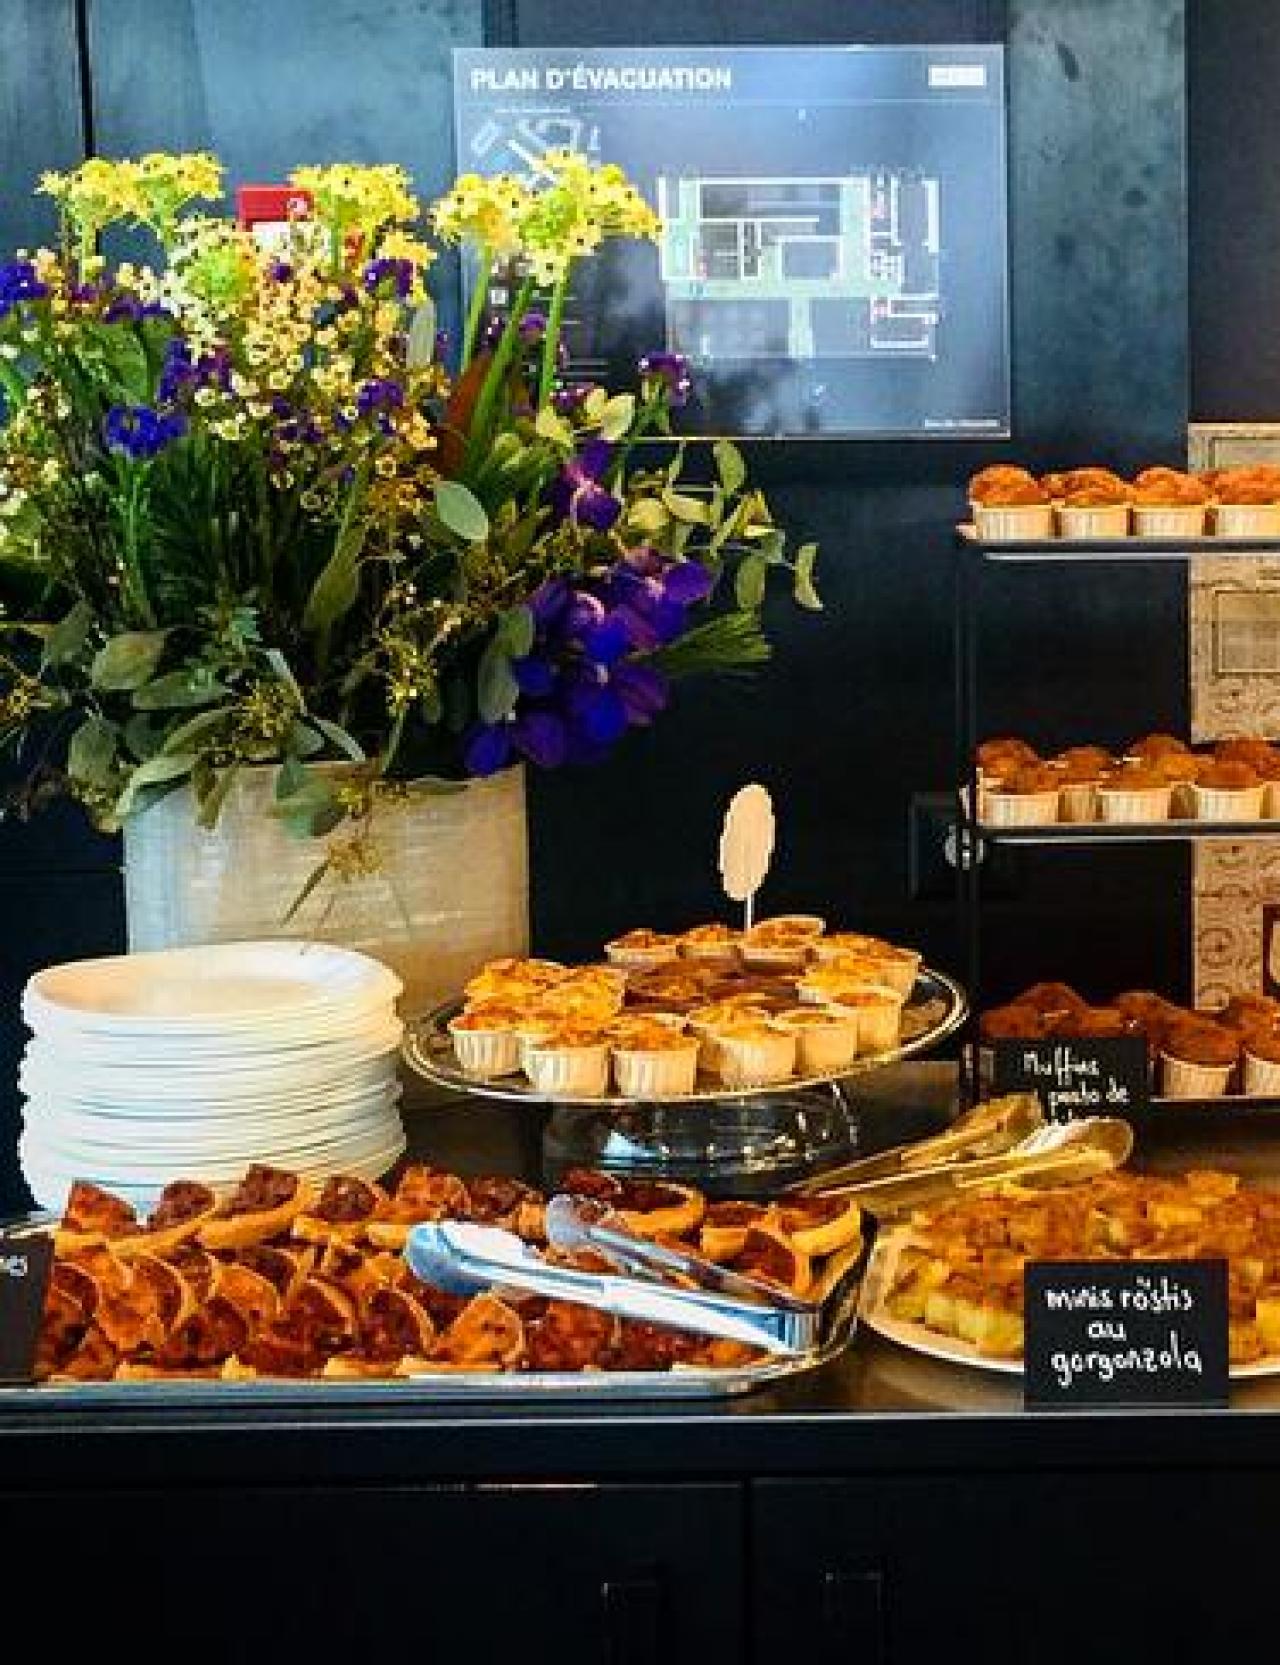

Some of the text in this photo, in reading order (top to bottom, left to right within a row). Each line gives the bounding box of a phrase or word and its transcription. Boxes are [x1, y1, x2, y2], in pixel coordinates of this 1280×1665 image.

[470, 61, 732, 90] PLAN D'ÉVACUATION
[1046, 1285, 1114, 1311] minis
[1088, 1320, 1127, 1341] au
[1050, 1330, 1202, 1388] gorgonzola
